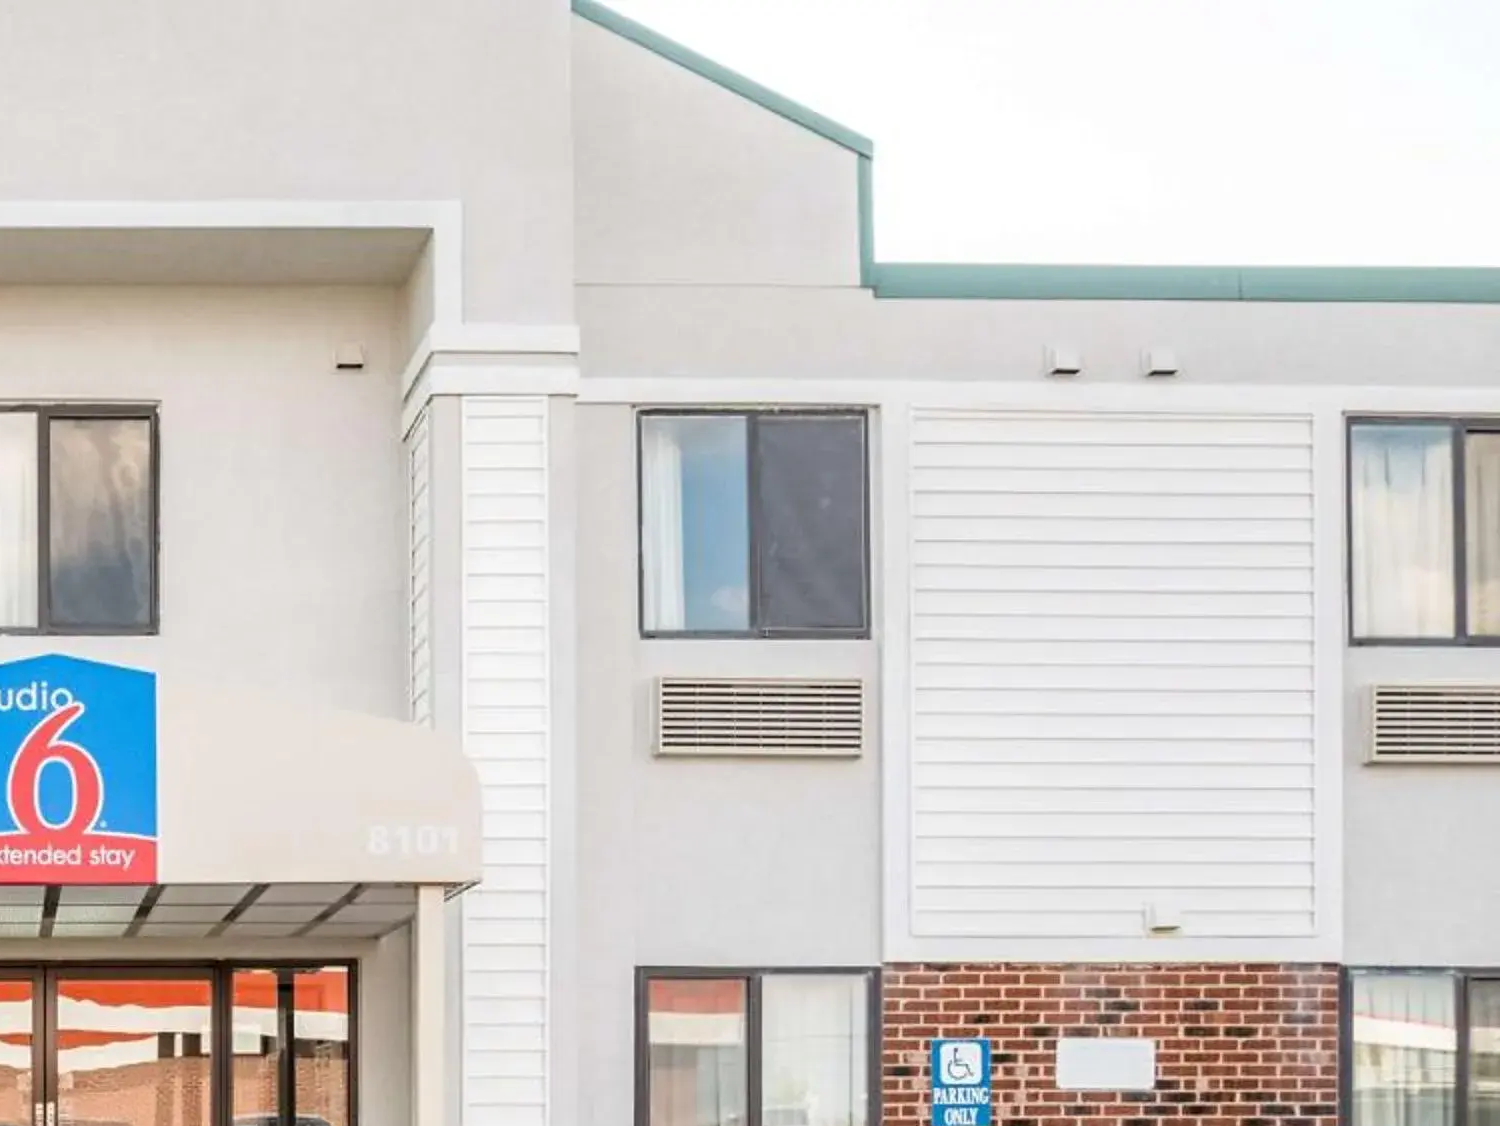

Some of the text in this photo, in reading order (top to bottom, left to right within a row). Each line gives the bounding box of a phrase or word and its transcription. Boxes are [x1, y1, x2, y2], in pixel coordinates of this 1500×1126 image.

[6, 701, 104, 834] 6
[367, 824, 459, 856] 8101
[89, 844, 136, 871] stay
[933, 1087, 989, 1105] PARKING
[944, 1107, 979, 1126] ONLY
